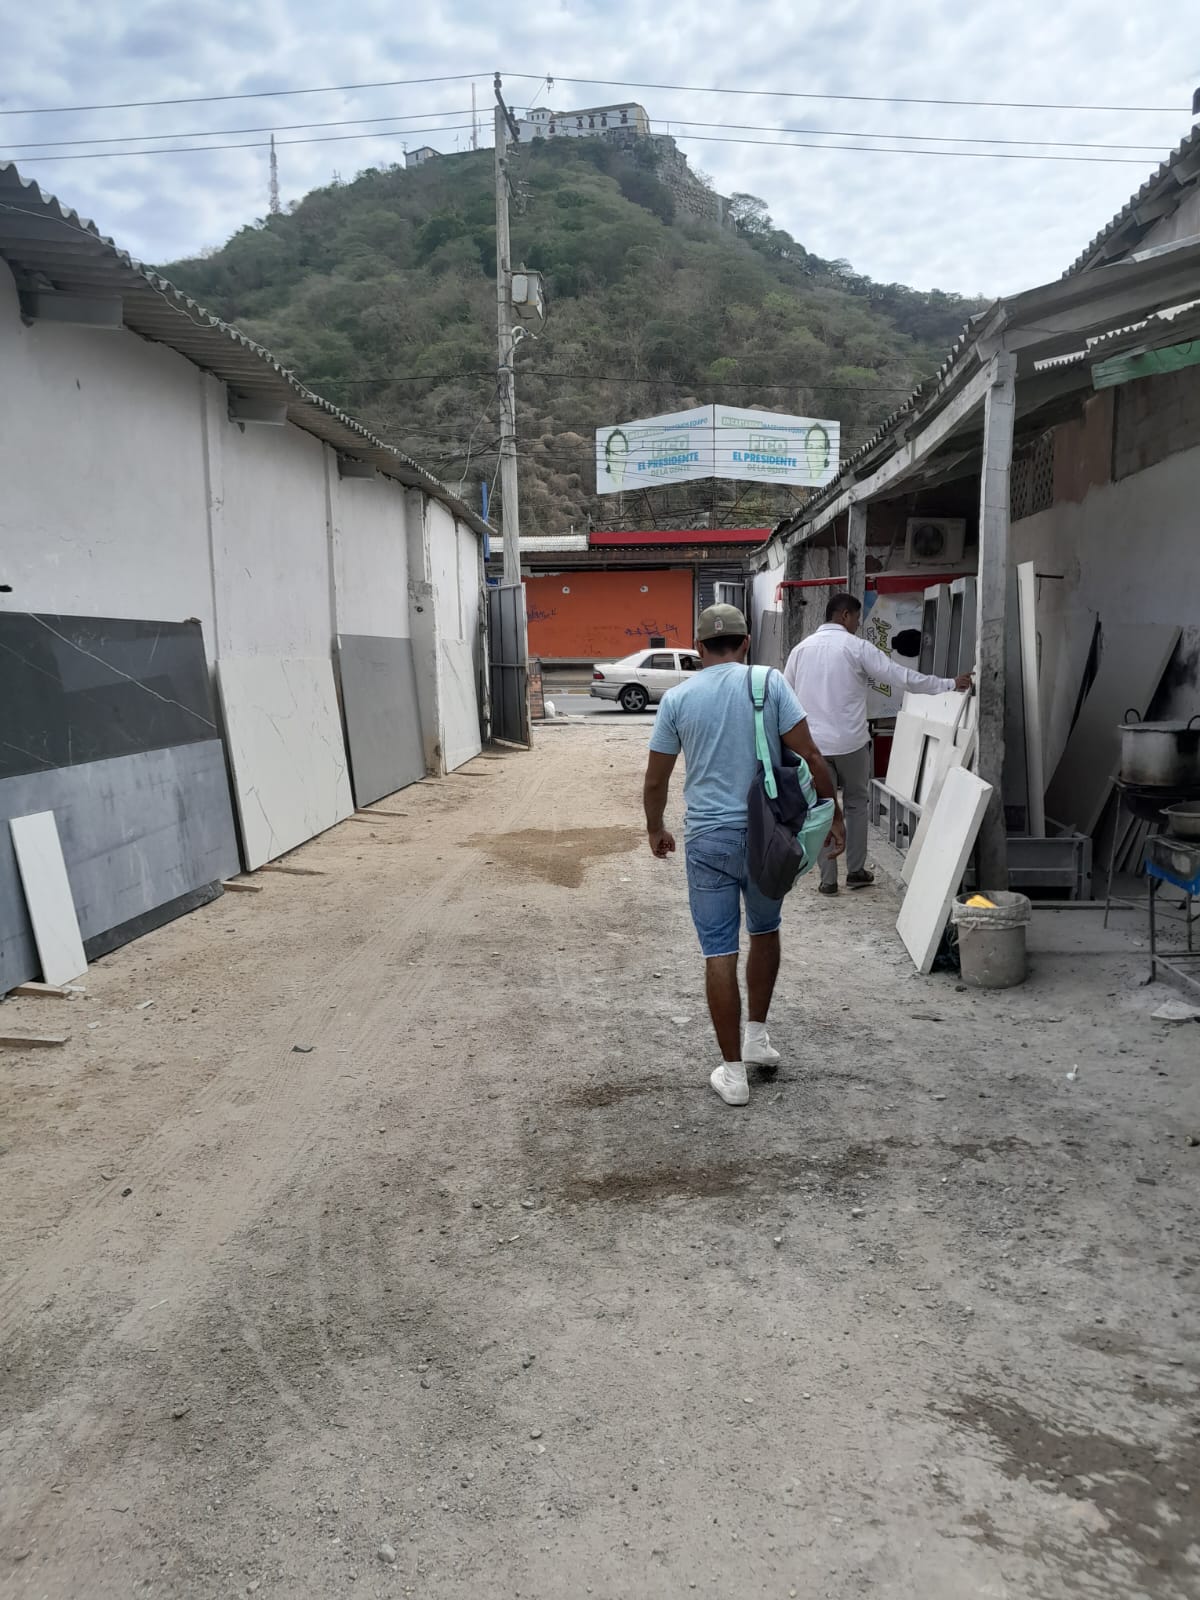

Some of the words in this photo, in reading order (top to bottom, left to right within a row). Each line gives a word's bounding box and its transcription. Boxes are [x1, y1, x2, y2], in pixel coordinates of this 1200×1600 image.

[637, 461, 647, 471] EL
[647, 451, 699, 469] PRESIDENTE
[732, 451, 742, 462] EL
[743, 452, 798, 467] PRESIDENTE
